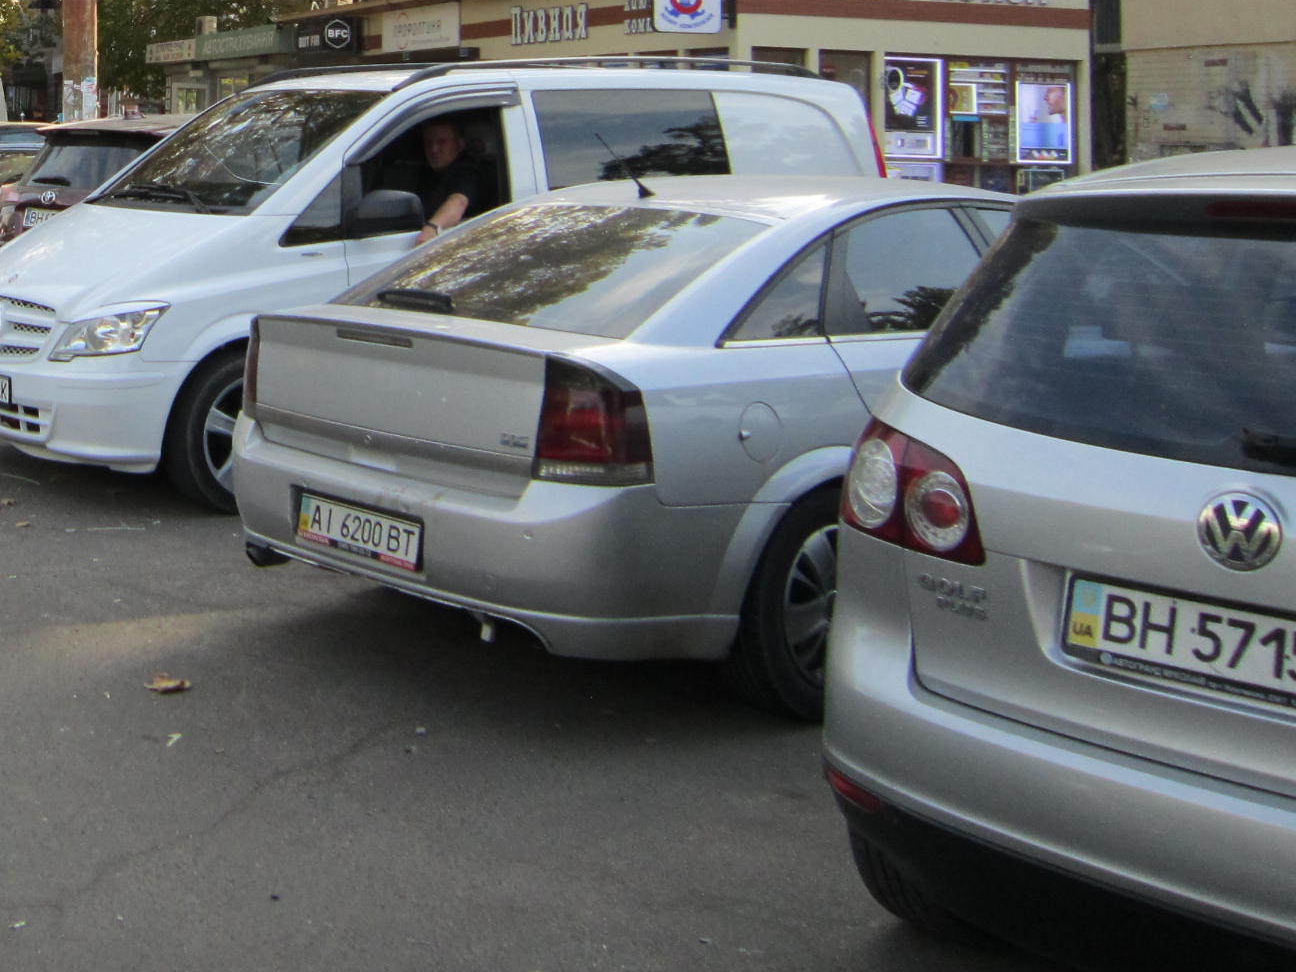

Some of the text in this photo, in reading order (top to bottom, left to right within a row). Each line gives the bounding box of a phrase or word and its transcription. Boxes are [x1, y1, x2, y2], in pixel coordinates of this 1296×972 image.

[327, 29, 349, 38] BFC
[340, 512, 383, 548] 6200
[386, 524, 416, 557] BT
[1072, 621, 1094, 638] UA
[1102, 593, 1177, 656] BH
